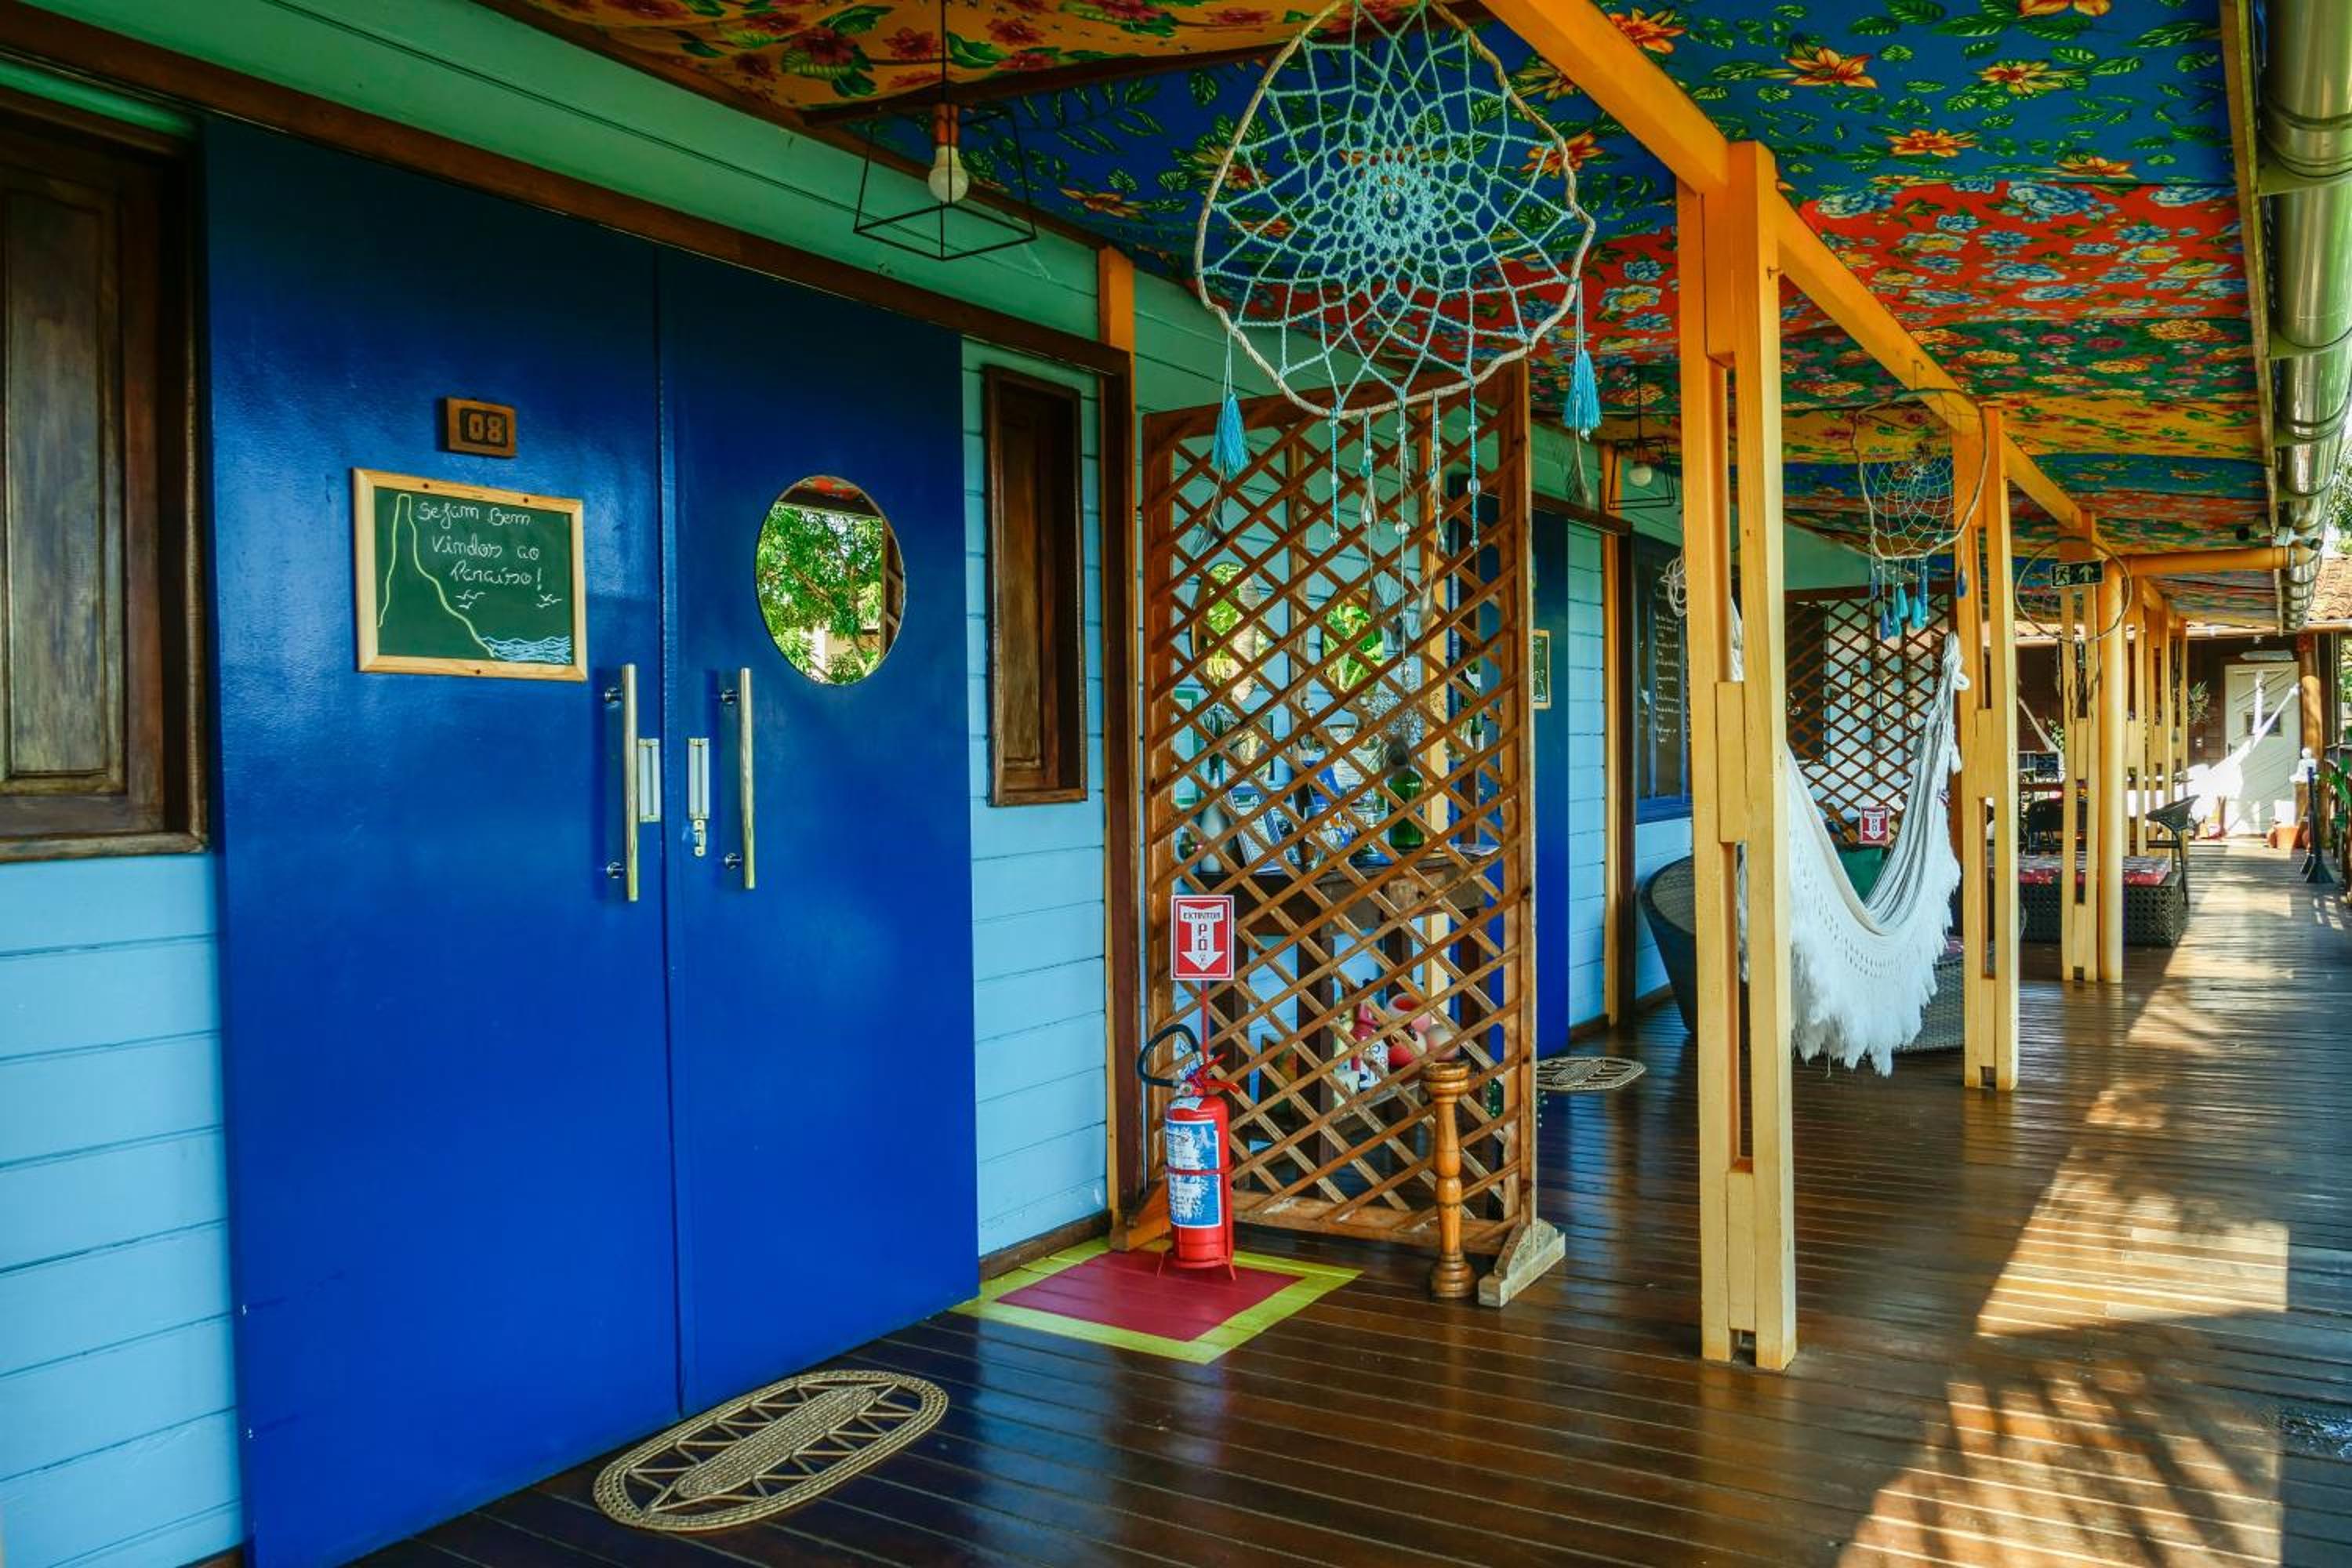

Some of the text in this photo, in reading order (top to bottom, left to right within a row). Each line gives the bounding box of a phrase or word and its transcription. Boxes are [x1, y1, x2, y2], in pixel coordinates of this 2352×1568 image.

[468, 413, 503, 443] 08
[487, 506, 532, 526] Bem
[517, 545, 540, 561] ao
[1182, 912, 1221, 920] EXTINTOR
